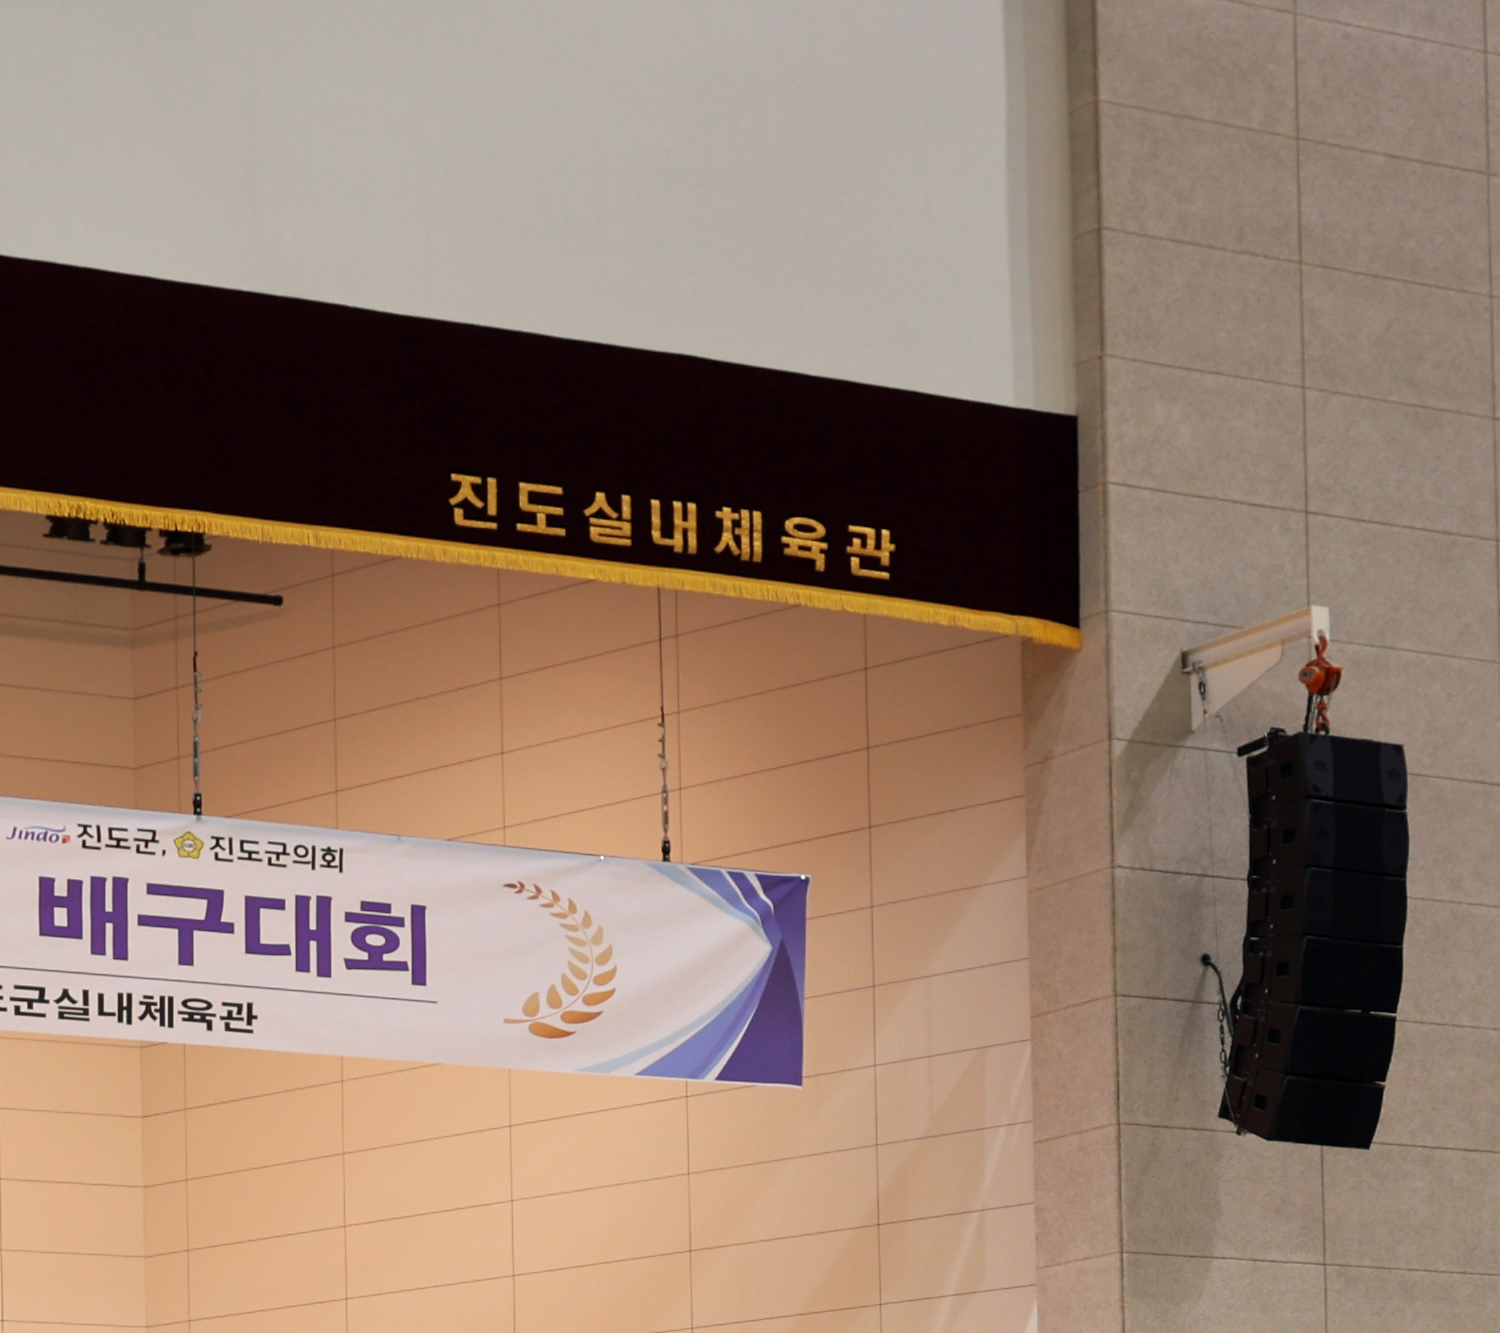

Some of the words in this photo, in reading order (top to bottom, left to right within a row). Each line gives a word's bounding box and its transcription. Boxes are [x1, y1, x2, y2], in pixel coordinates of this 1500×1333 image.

[448, 472, 897, 580] 진도실내체육관
[6, 826, 60, 844] Jindo
[77, 823, 167, 857] 진도군,
[208, 834, 345, 873] 진도군의회
[37, 875, 428, 987] 배구대회
